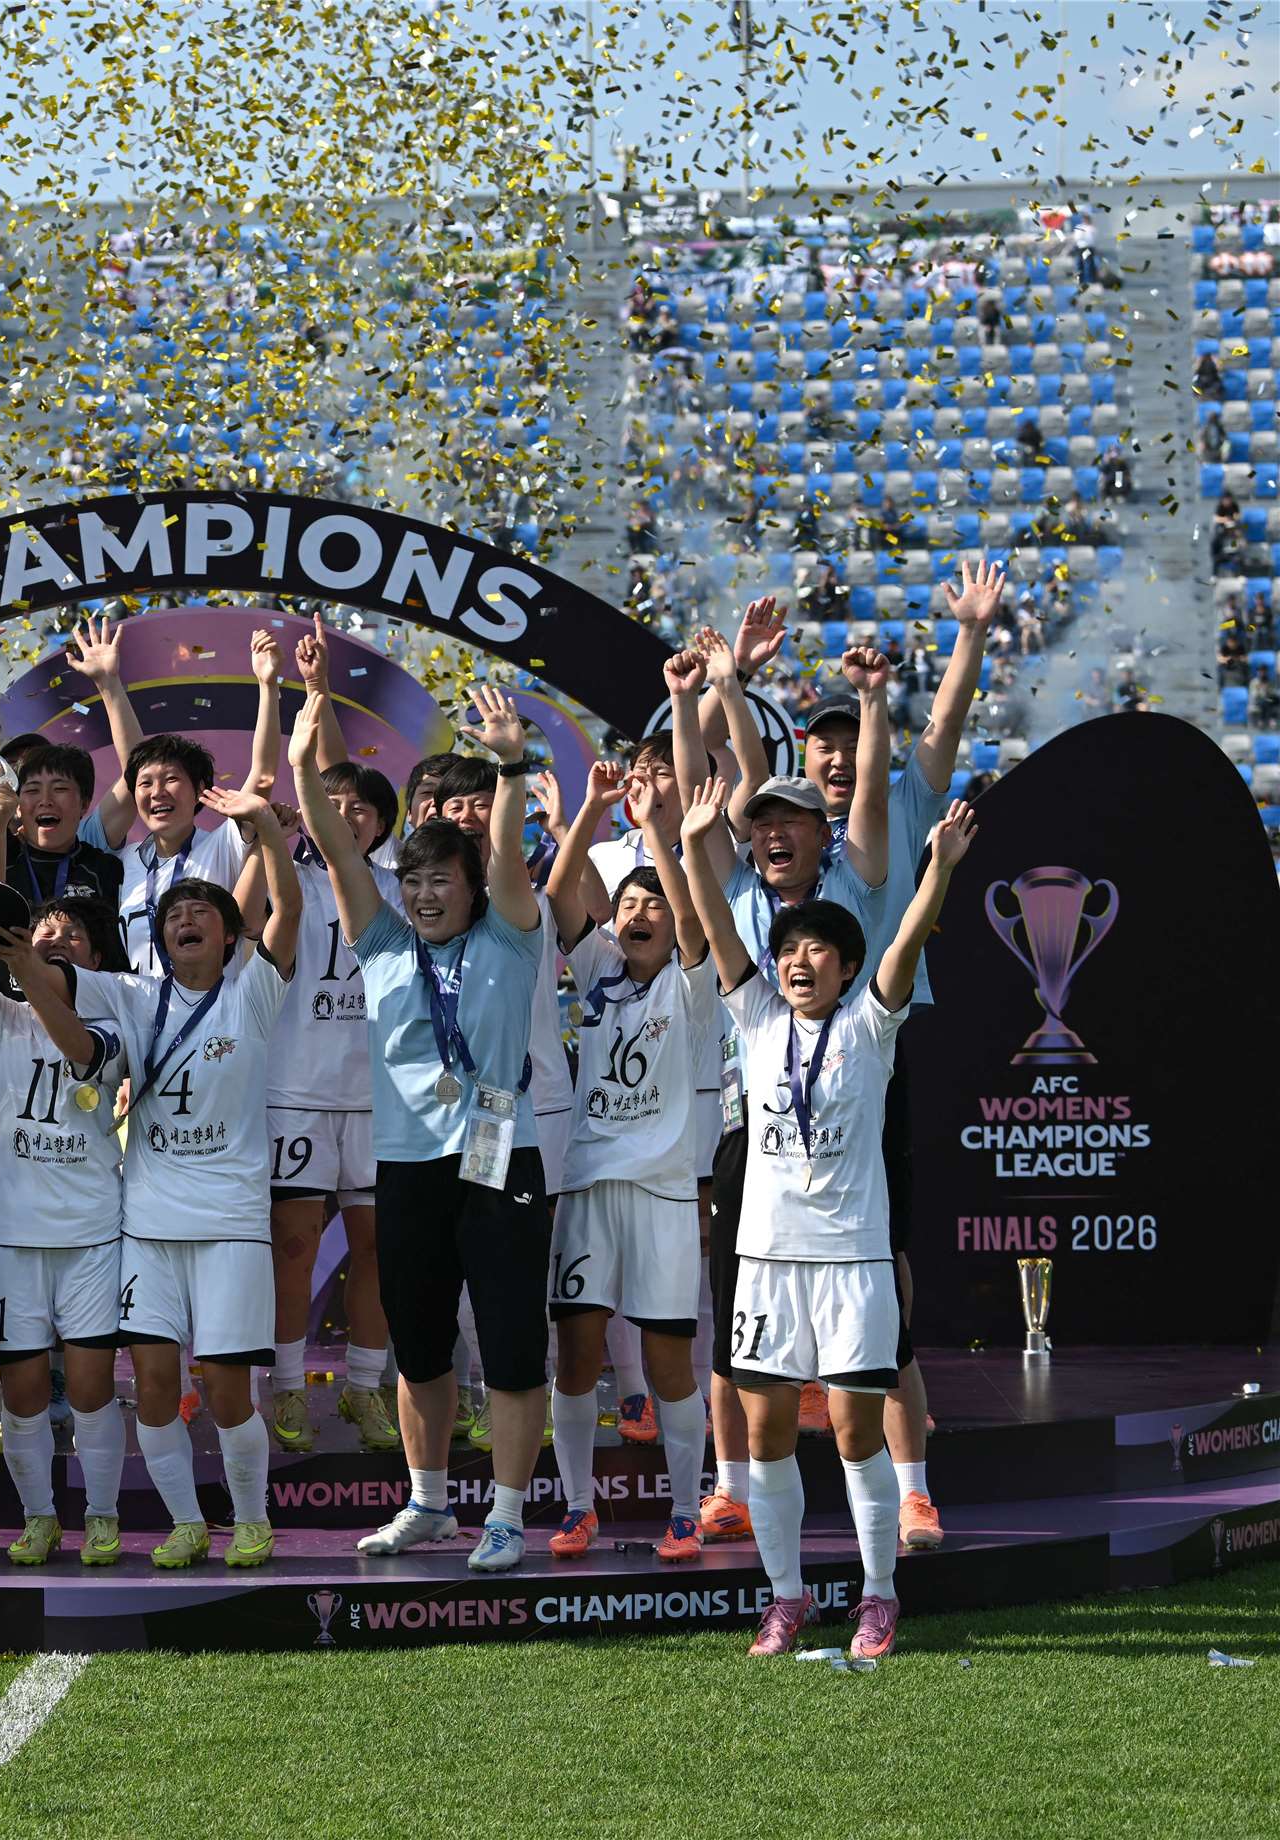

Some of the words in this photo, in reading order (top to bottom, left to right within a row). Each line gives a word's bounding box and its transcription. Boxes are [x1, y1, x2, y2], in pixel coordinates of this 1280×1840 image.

[320, 919, 361, 981] 1
[337, 992, 366, 1010] 내고향
[600, 1021, 648, 1088] 16
[16, 1058, 62, 1124] 11
[158, 1049, 197, 1115] 4
[1032, 1076, 1079, 1094] AFC
[979, 1096, 1132, 1121] WOMEN'S
[33, 1133, 87, 1153] 내고향회사
[170, 1121, 227, 1145] 내고향회사
[960, 1125, 1151, 1149] CHAMPIONS
[271, 1136, 312, 1179] 19
[958, 1216, 1057, 1251] FINALS
[1071, 1215, 1157, 1251] 2026
[551, 1252, 591, 1299] 16
[120, 1274, 138, 1320] 4
[731, 1310, 767, 1361] 31
[1195, 1424, 1261, 1456] WOMEN'S
[273, 1480, 411, 1507] WOMEN'
[1232, 1518, 1280, 1551] WOMEN'
[350, 1603, 360, 1630] AFC
[364, 1598, 527, 1630] WOMEN'S
[535, 1589, 729, 1624] CHAMPIONS
